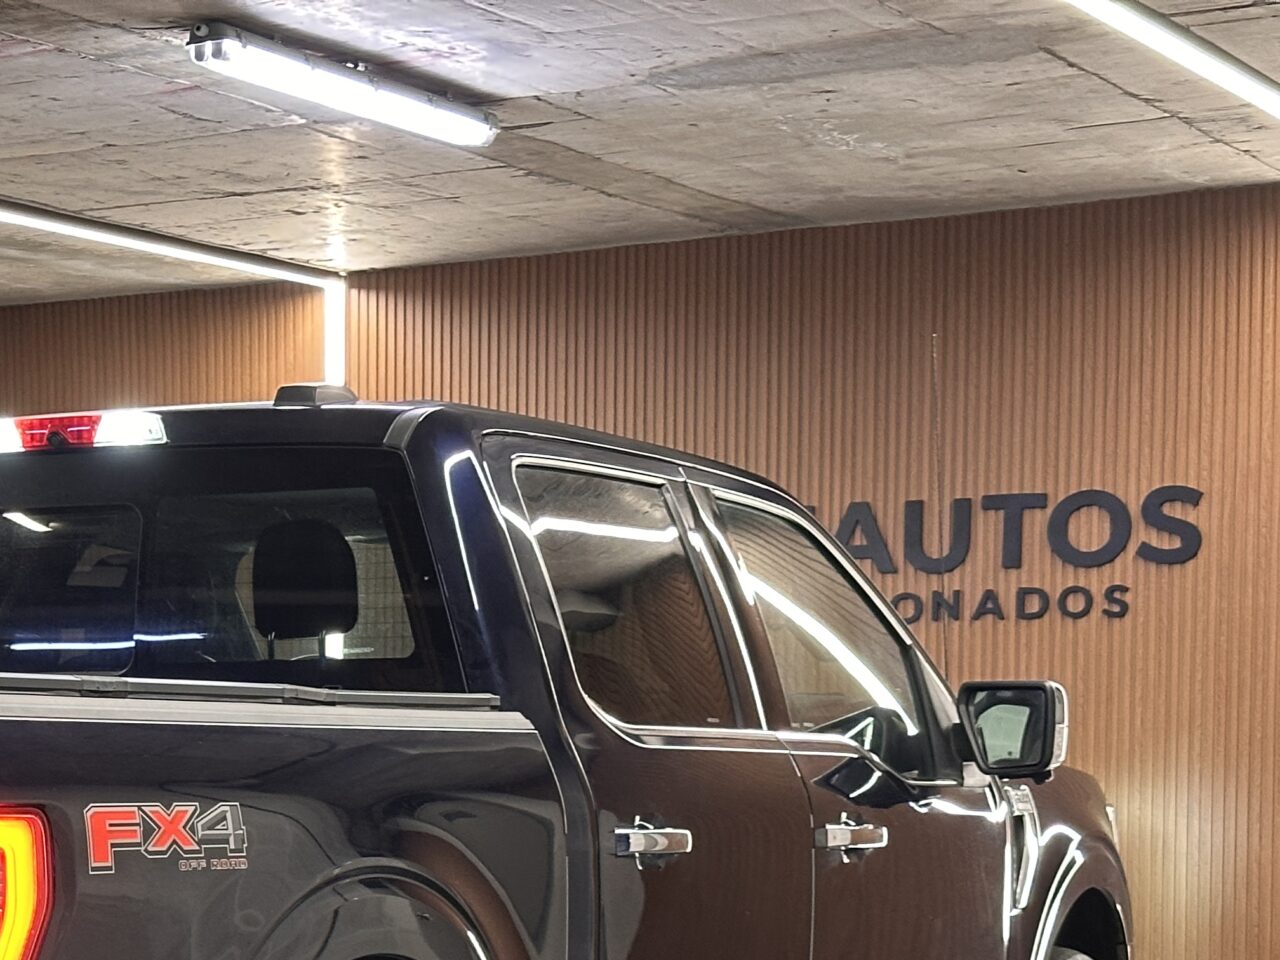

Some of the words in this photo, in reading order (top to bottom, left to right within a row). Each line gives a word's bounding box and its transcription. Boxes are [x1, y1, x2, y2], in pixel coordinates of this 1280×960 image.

[805, 485, 1204, 575] AUTOS
[84, 802, 247, 874] FX4
[179, 859, 206, 871] OFF
[211, 858, 248, 870] ROAD
